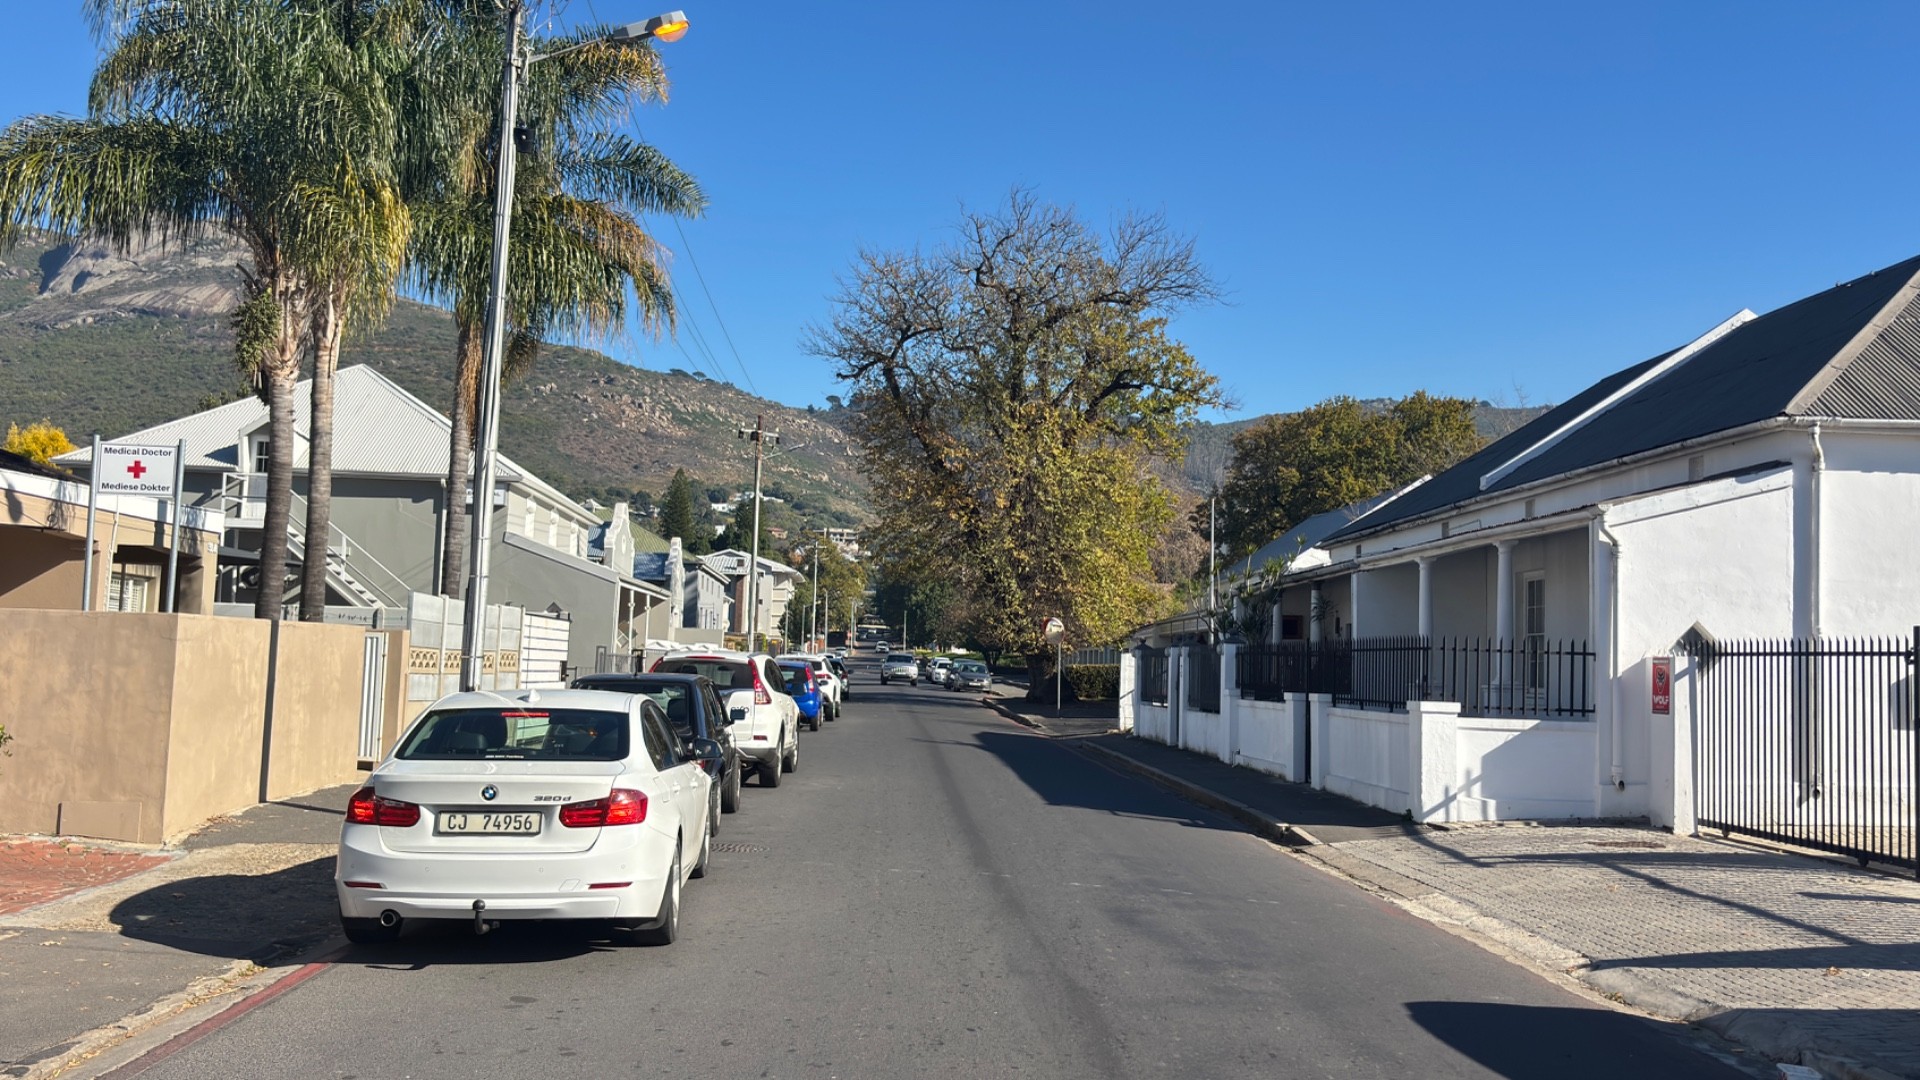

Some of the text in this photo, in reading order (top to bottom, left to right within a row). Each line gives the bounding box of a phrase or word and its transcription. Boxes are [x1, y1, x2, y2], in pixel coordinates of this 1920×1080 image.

[104, 447, 172, 456] Medical Doctor
[101, 482, 170, 492] Mediese Dokter
[447, 814, 533, 831] CJ 74956
